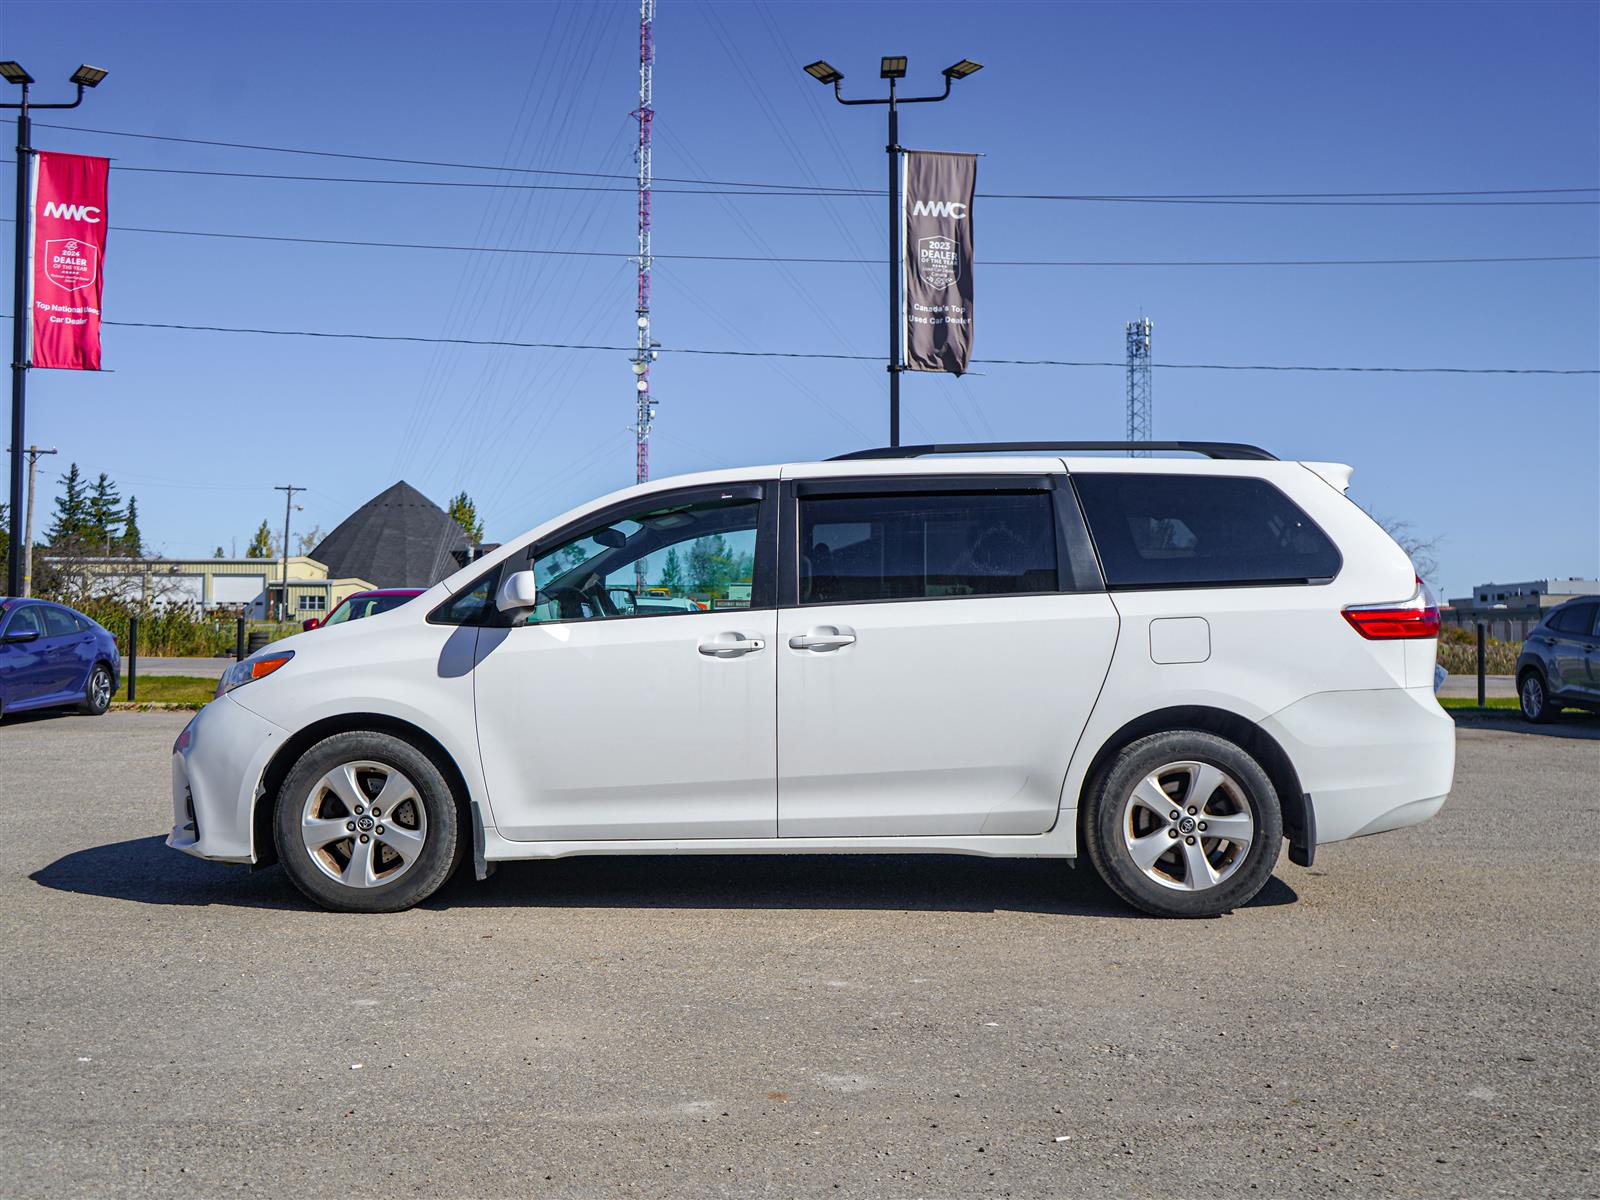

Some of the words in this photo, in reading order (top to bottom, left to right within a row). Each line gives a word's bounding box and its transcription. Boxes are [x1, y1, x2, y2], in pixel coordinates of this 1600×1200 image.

[43, 201, 101, 223] MWC
[913, 200, 967, 219] MWC
[928, 241, 951, 250] 2023
[62, 249, 80, 257] 2024
[921, 249, 958, 260] DEALER
[53, 255, 87, 266] DEALER
[36, 301, 51, 311] Top
[51, 304, 83, 313] National
[914, 303, 949, 313] Canada's
[951, 304, 966, 315] Top
[49, 315, 64, 323] Car
[65, 317, 88, 325] Dealer
[908, 315, 928, 325] Used
[929, 317, 943, 325] Car
[945, 316, 971, 325] Dealer
